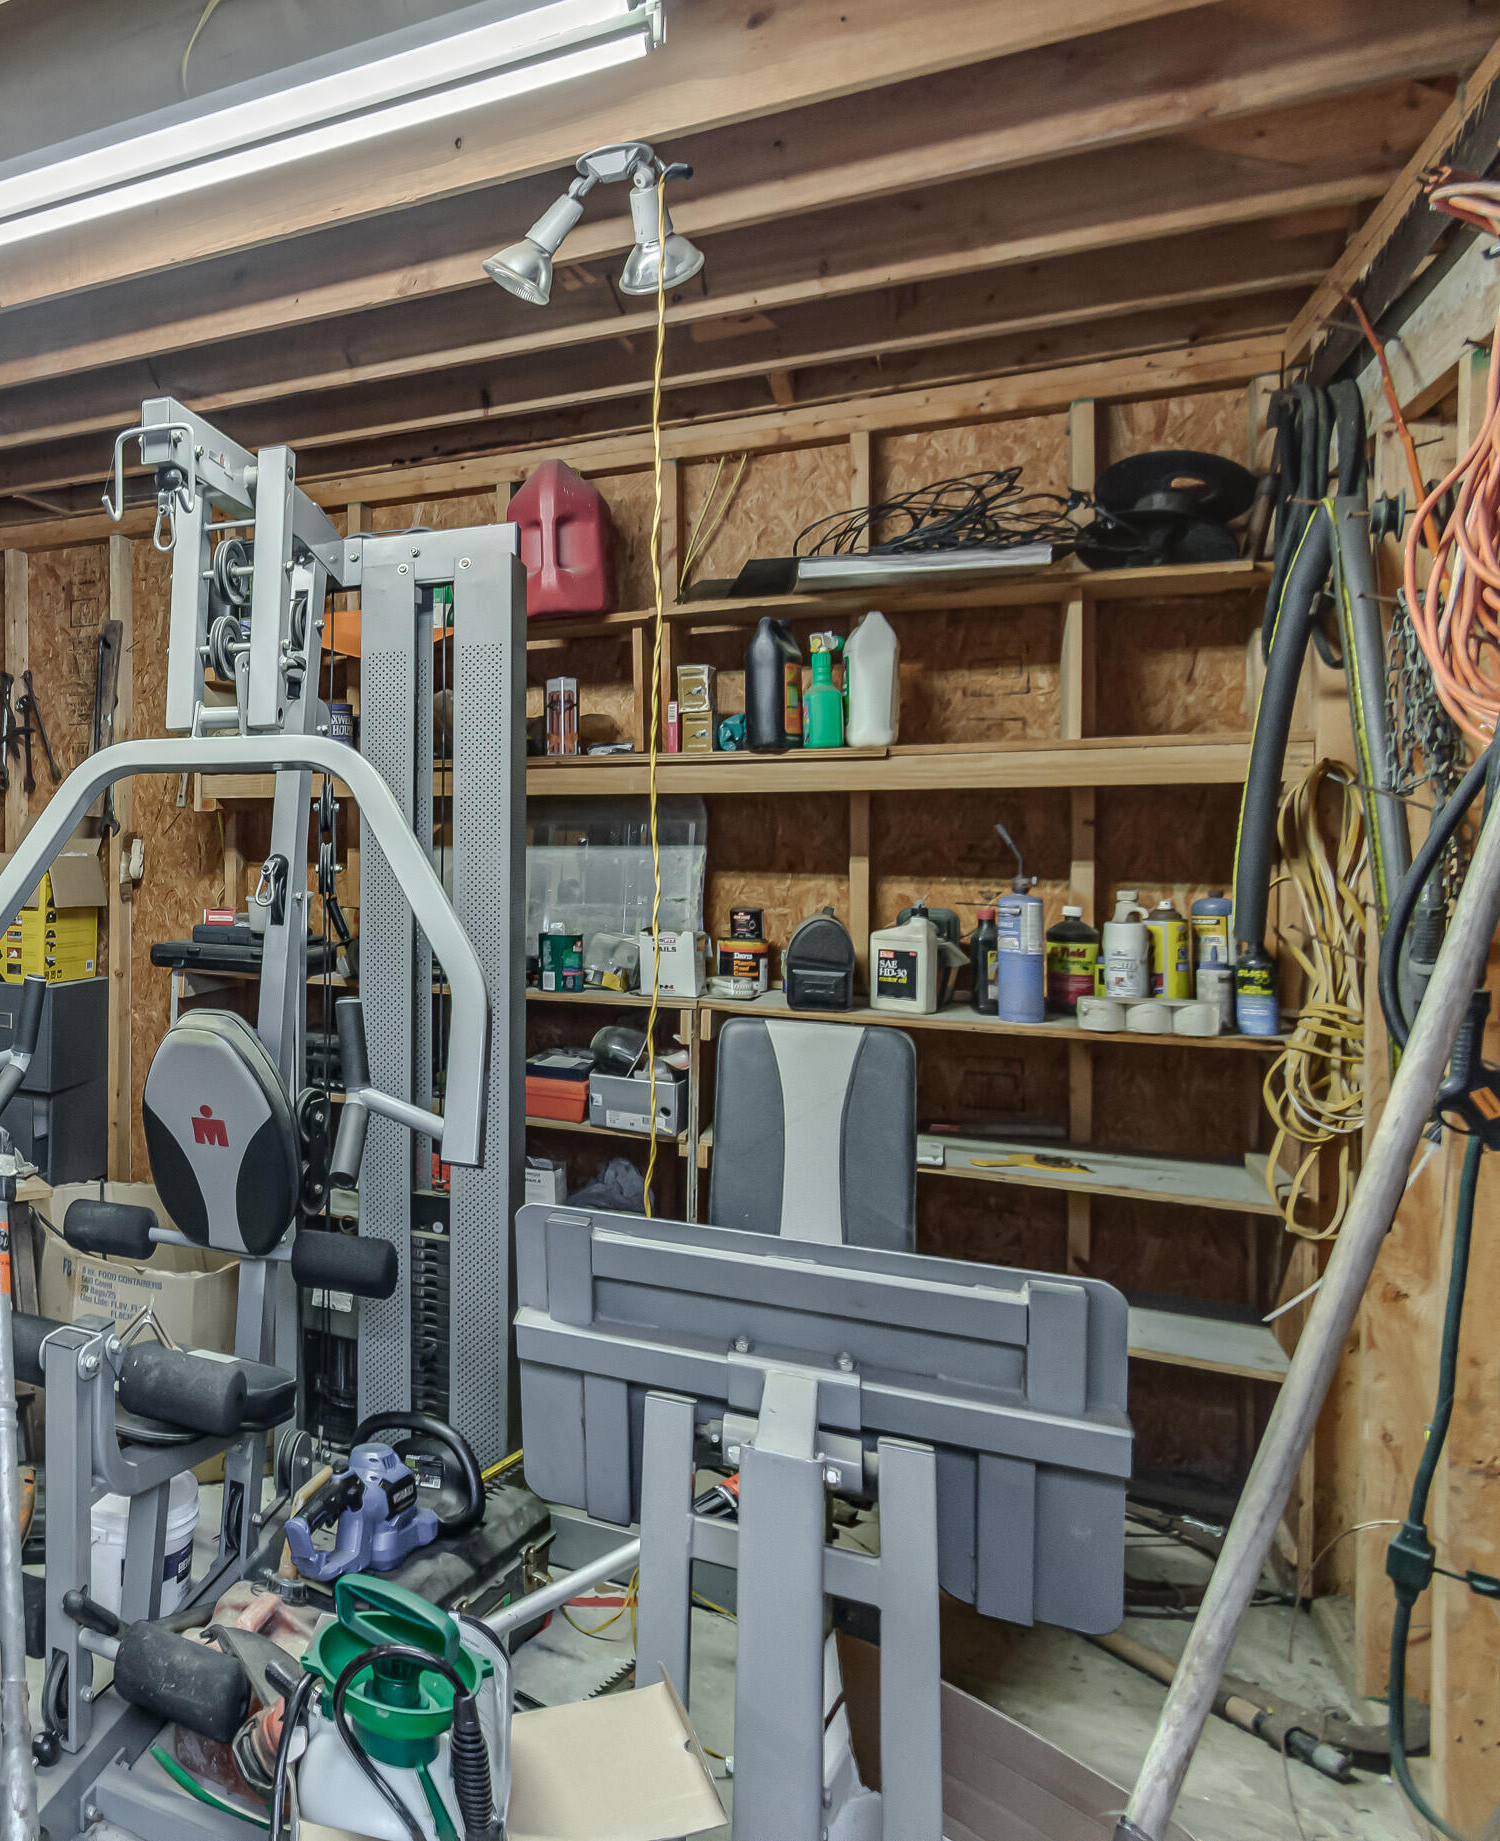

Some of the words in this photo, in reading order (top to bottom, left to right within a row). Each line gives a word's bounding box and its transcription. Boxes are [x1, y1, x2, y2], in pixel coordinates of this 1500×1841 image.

[879, 960, 898, 968] SAE
[879, 968, 908, 978] HD-30
[118, 1275, 163, 1290] CONTAINERS
